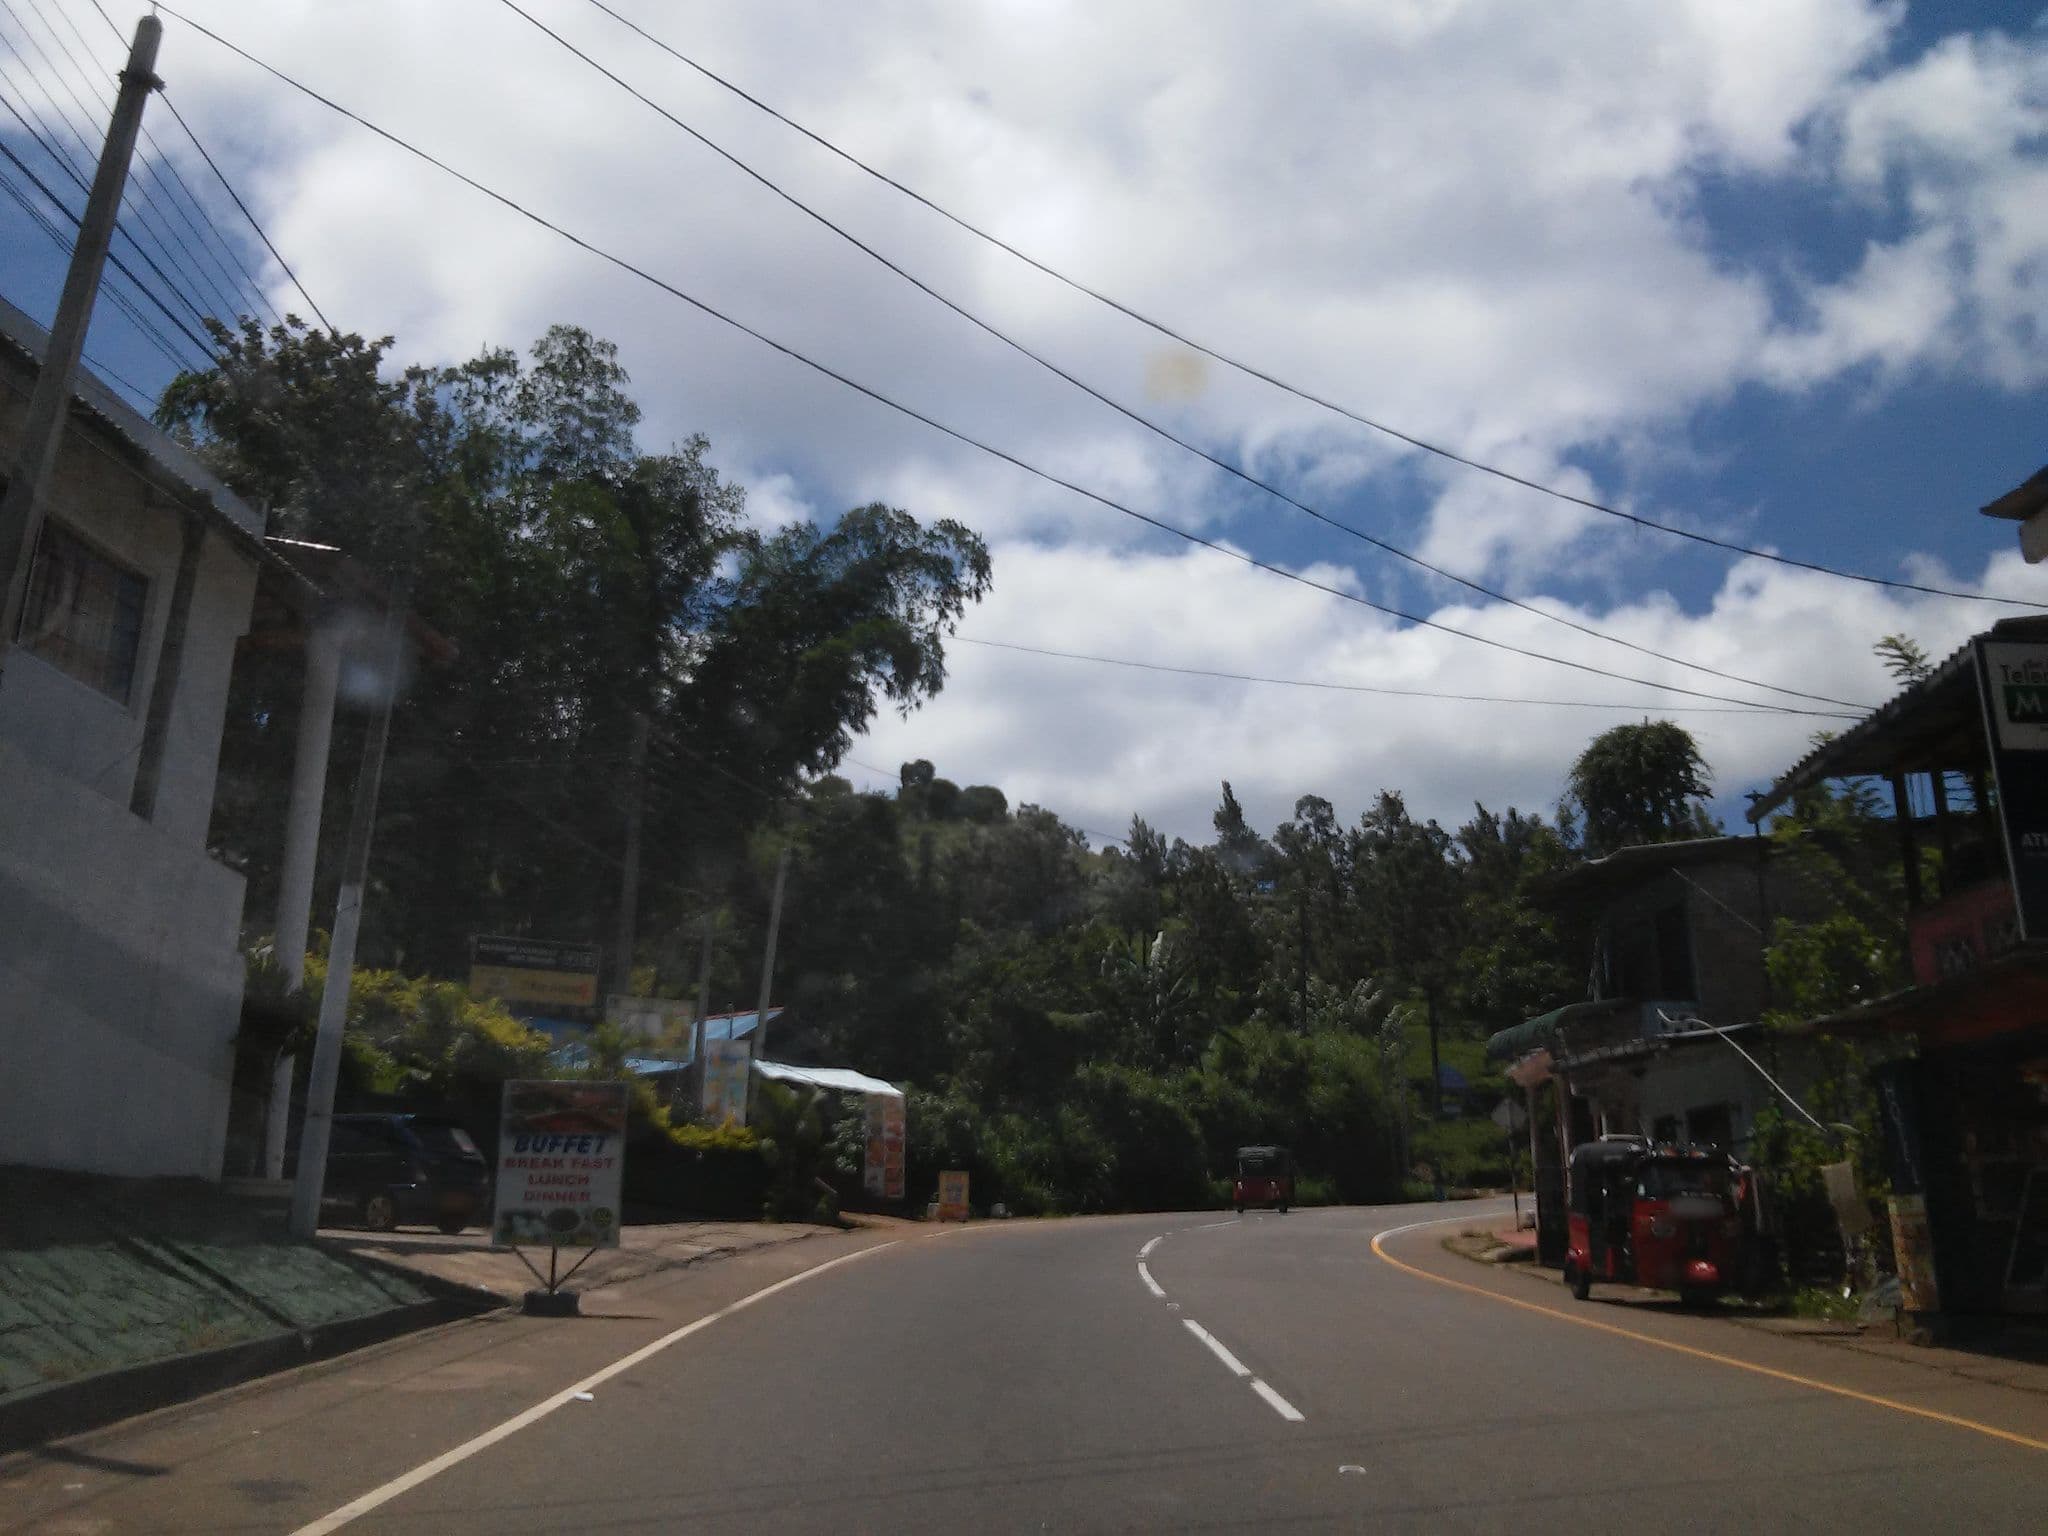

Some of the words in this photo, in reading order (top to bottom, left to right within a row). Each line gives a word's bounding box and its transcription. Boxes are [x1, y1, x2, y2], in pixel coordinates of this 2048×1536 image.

[514, 1135, 606, 1153] BUFFET
[505, 1158, 564, 1169] BREAK
[571, 1158, 614, 1169] FAST
[527, 1174, 590, 1185] LUNCH
[522, 1190, 591, 1202] DINNER
